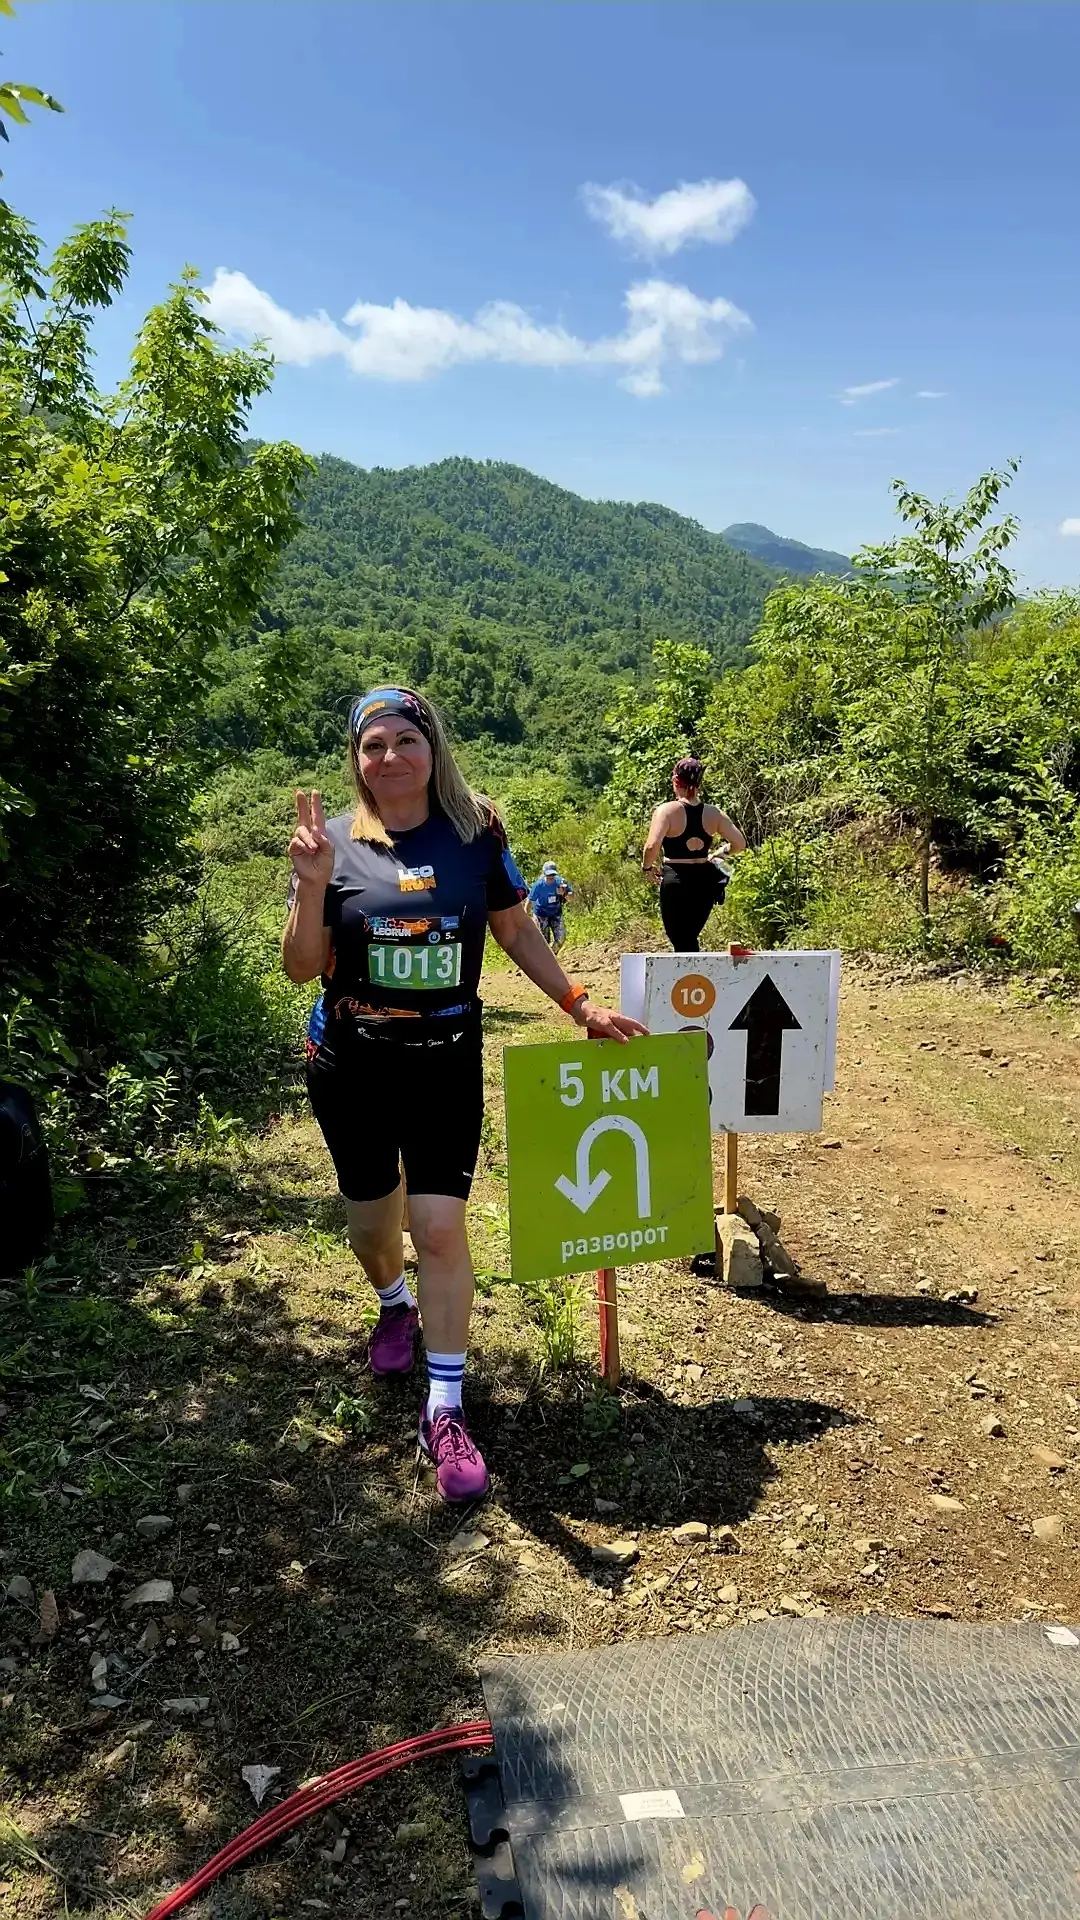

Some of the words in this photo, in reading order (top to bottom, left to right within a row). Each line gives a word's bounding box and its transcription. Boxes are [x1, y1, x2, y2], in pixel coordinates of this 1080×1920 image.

[397, 865, 434, 880] LEO
[400, 876, 436, 892] RUN
[373, 927, 411, 937] LEORUN
[371, 946, 454, 979] 1013
[680, 987, 706, 1005] 10
[559, 1061, 584, 1107] 5
[561, 1226, 669, 1263] разворот
